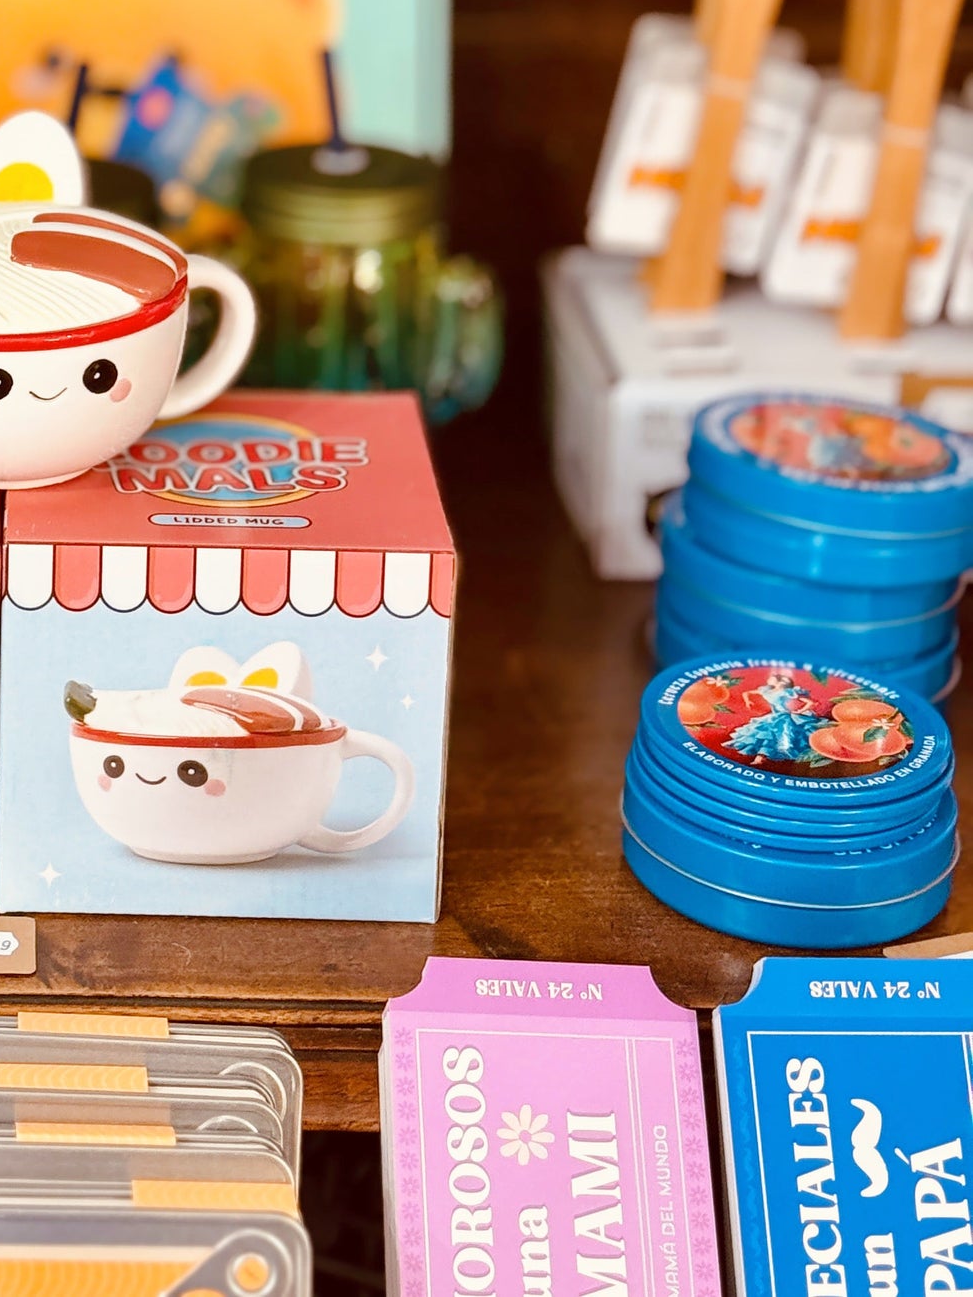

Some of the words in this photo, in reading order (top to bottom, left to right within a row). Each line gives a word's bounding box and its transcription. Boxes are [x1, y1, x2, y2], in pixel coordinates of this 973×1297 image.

[107, 436, 369, 471] OODIE
[112, 465, 348, 493] MALS
[173, 515, 238, 525] LIDDED
[245, 517, 284, 527] MUG
[682, 741, 766, 781] ELABORADO
[785, 774, 896, 790] EMBOTELLADO
[894, 766, 914, 778] EN
[909, 735, 936, 769] GRANADA
[475, 979, 541, 999] VALES
[548, 982, 574, 999] 24
[809, 980, 878, 999] VALES
[883, 981, 910, 999] 24
[441, 1045, 497, 1297] OROSOS
[653, 1125, 672, 1196] MUNDO
[566, 1110, 628, 1297] MAMI
[659, 1201, 675, 1236] DEL
[894, 1138, 973, 1297] PAPÁ
[864, 1232, 899, 1297] un
